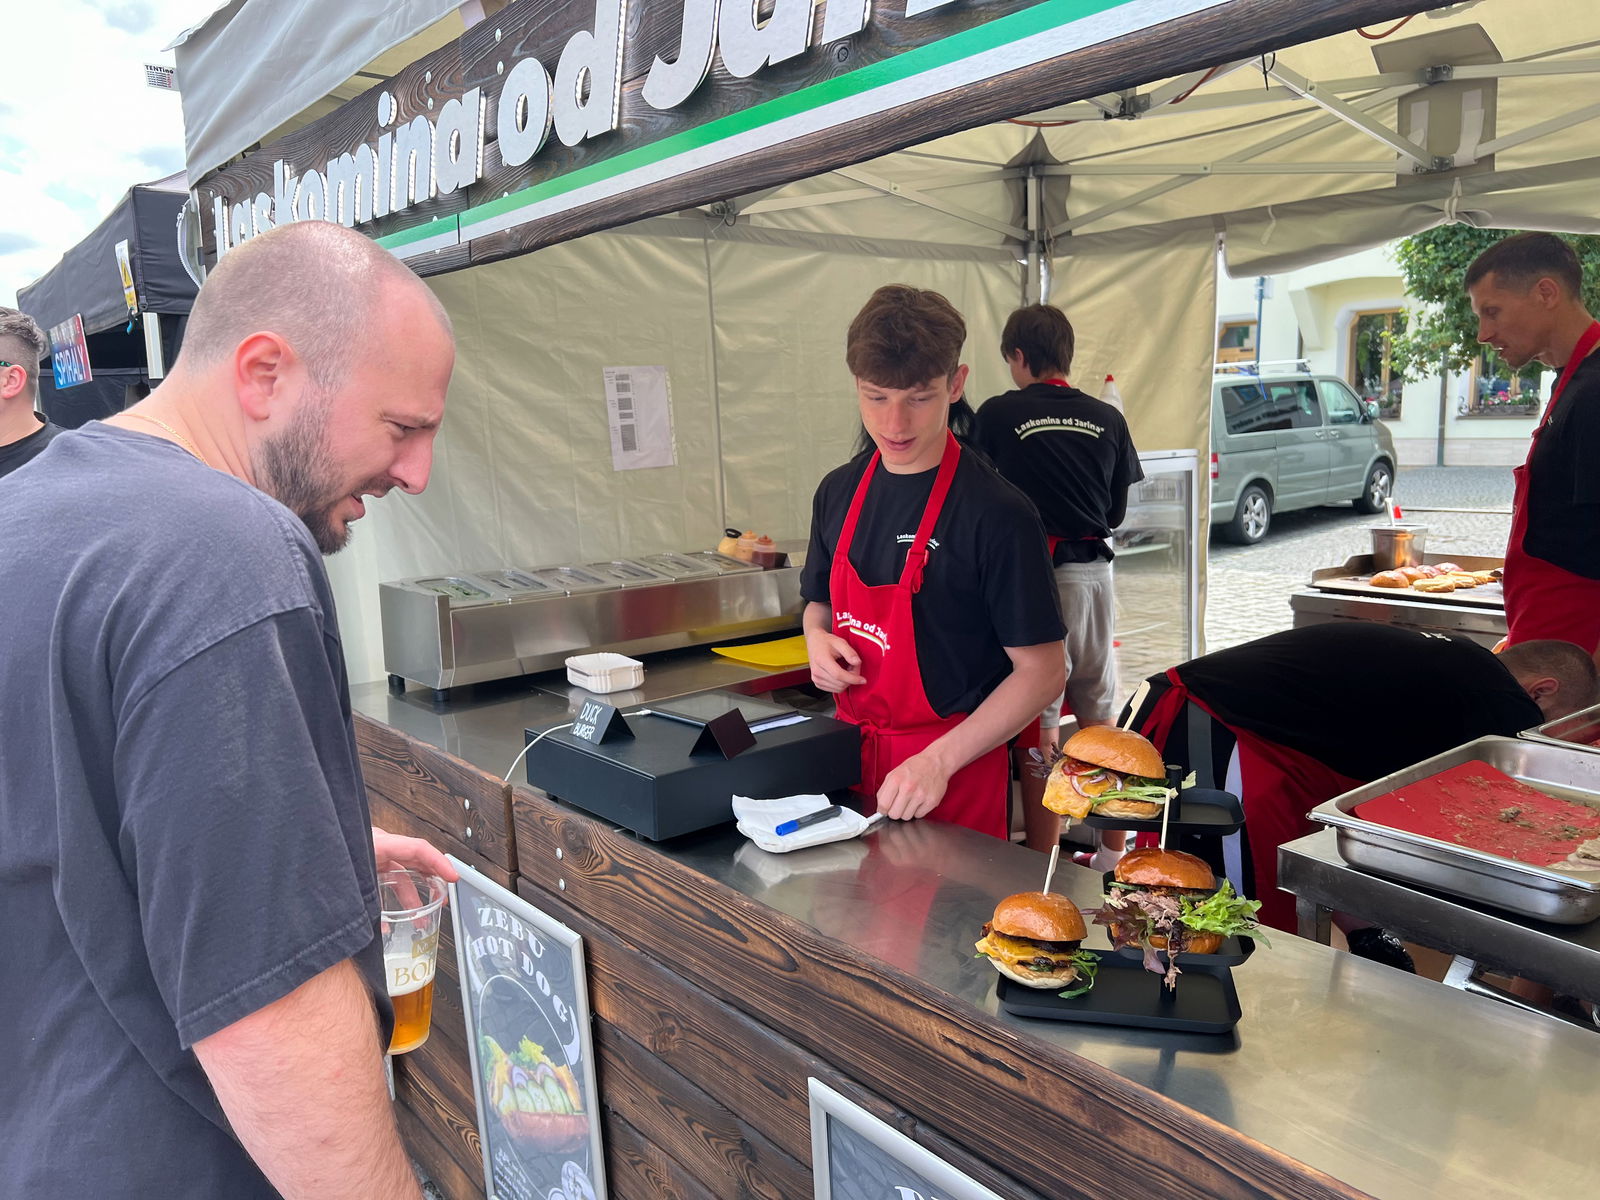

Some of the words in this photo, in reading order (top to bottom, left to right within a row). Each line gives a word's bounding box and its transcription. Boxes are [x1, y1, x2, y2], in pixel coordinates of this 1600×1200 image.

[497, 0, 621, 168] od
[54, 343, 87, 386] SPIRALY
[1014, 415, 1061, 436] Laskomina
[1062, 417, 1073, 425] od
[863, 622, 876, 633] od
[580, 701, 603, 725] DUCK
[573, 721, 596, 740] BURGER
[478, 907, 546, 959] ZEBU
[472, 935, 514, 961] HOT
[521, 951, 568, 1023] DOG
